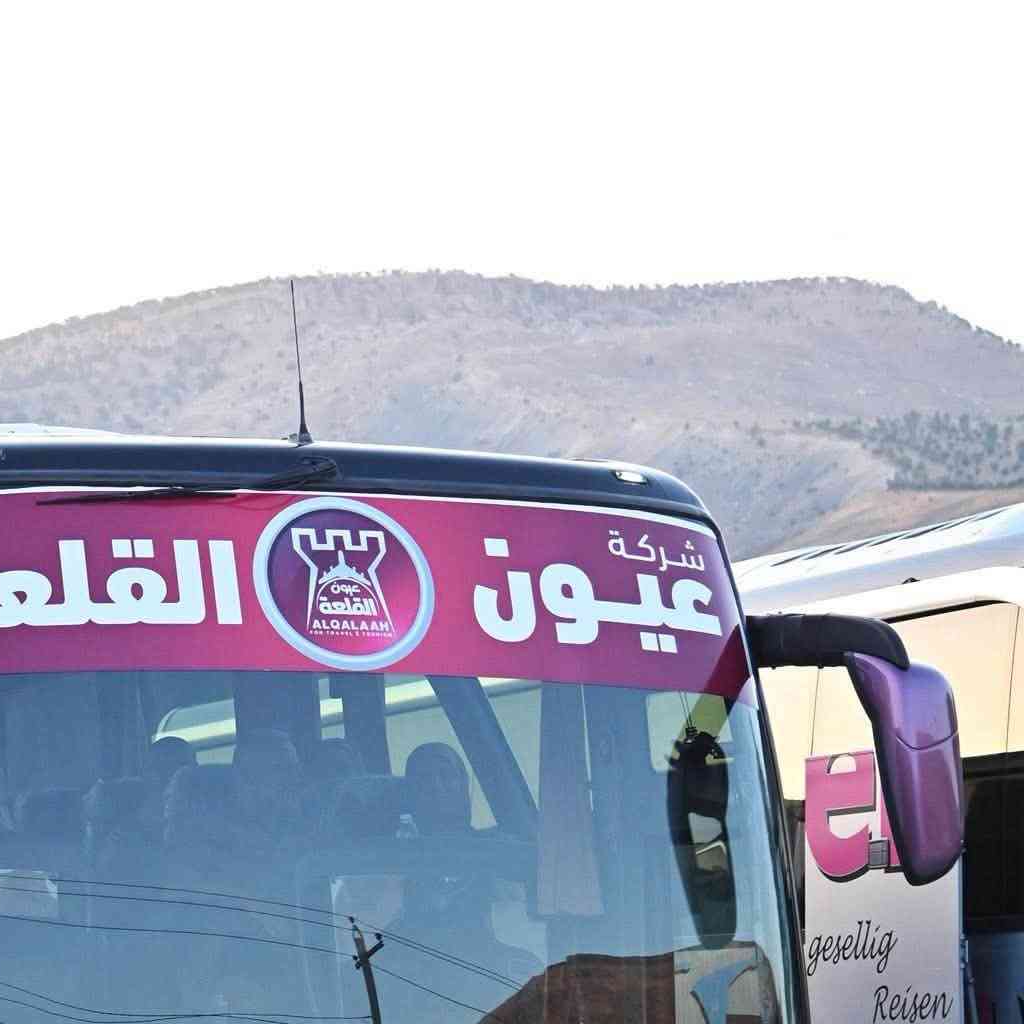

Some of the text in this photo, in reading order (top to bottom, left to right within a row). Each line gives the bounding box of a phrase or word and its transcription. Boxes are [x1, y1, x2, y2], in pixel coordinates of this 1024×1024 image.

[608, 529, 705, 571] شركة
[319, 596, 378, 616] القلعة
[473, 537, 723, 653] عيون
[312, 619, 390, 631] ALQALAAH
[806, 919, 898, 977] gesellig
[873, 984, 954, 1024] Reisen
